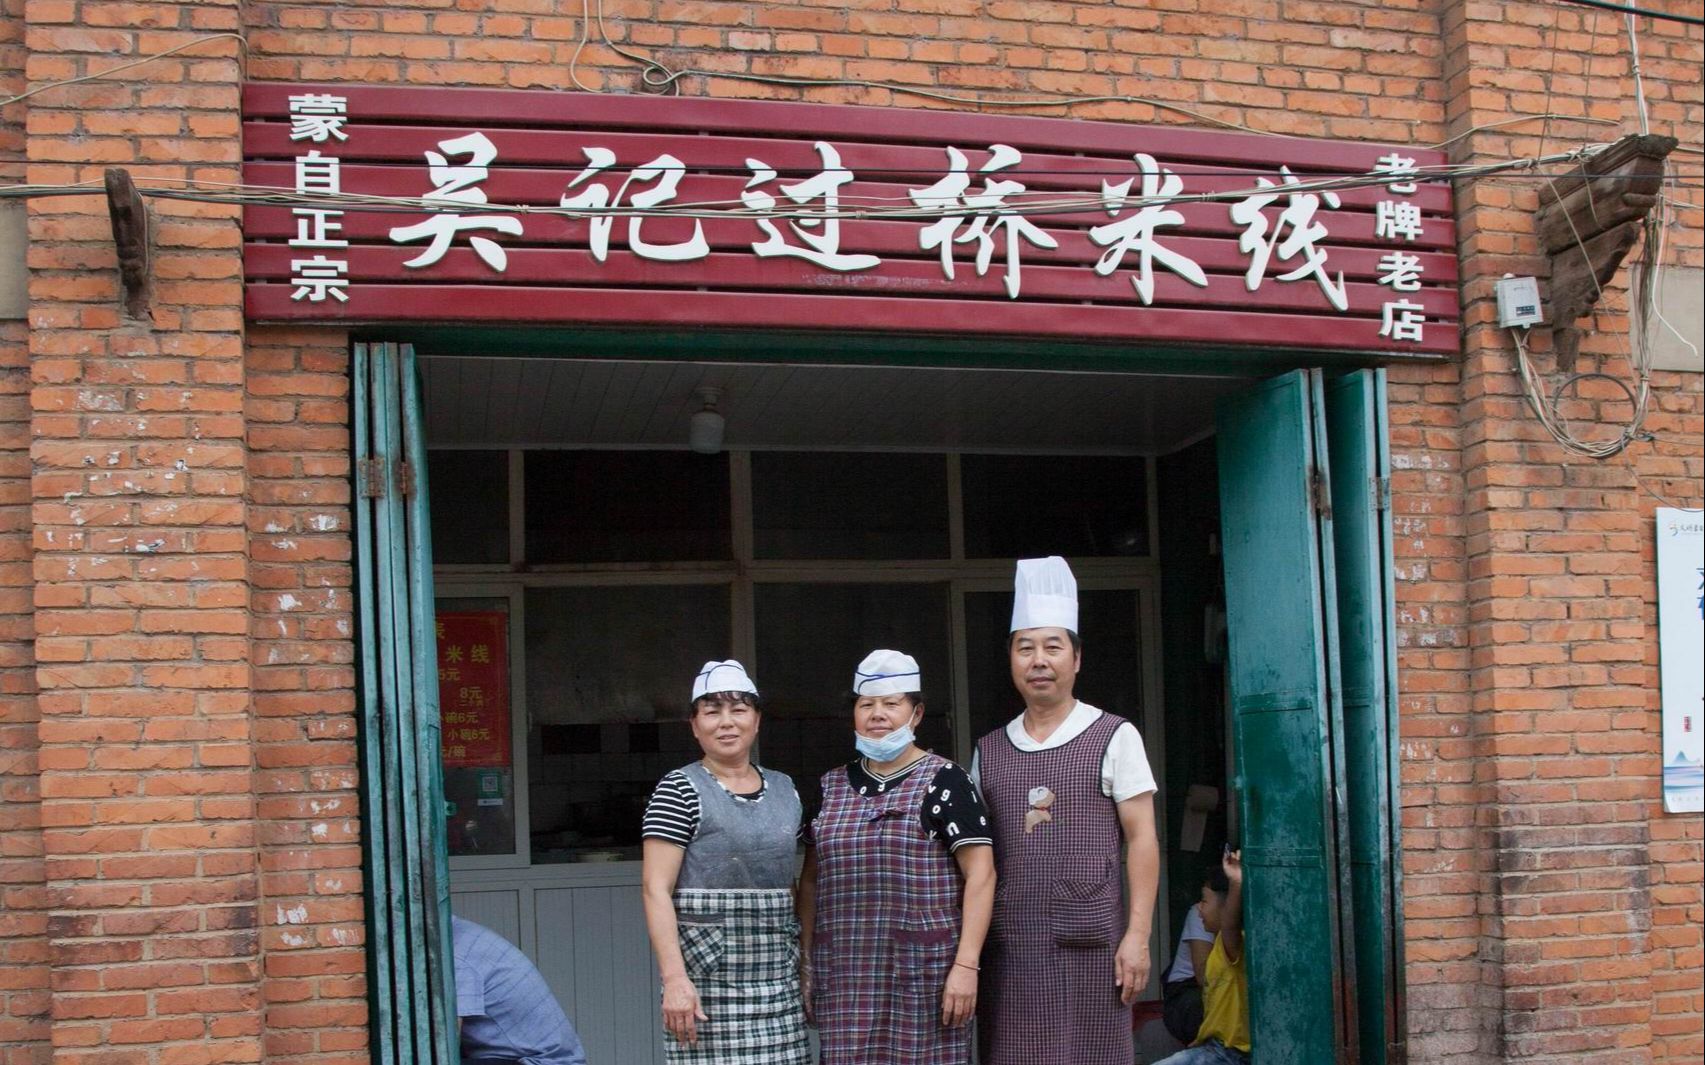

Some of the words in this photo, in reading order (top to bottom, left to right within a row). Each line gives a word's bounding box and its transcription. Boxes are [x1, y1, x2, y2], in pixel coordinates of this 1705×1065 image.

[288, 93, 350, 303] 蒙自正宗
[389, 131, 1349, 311] 吴记过桥米线
[1374, 152, 1427, 343] 老牌老店
[441, 711, 479, 724] 碗6元
